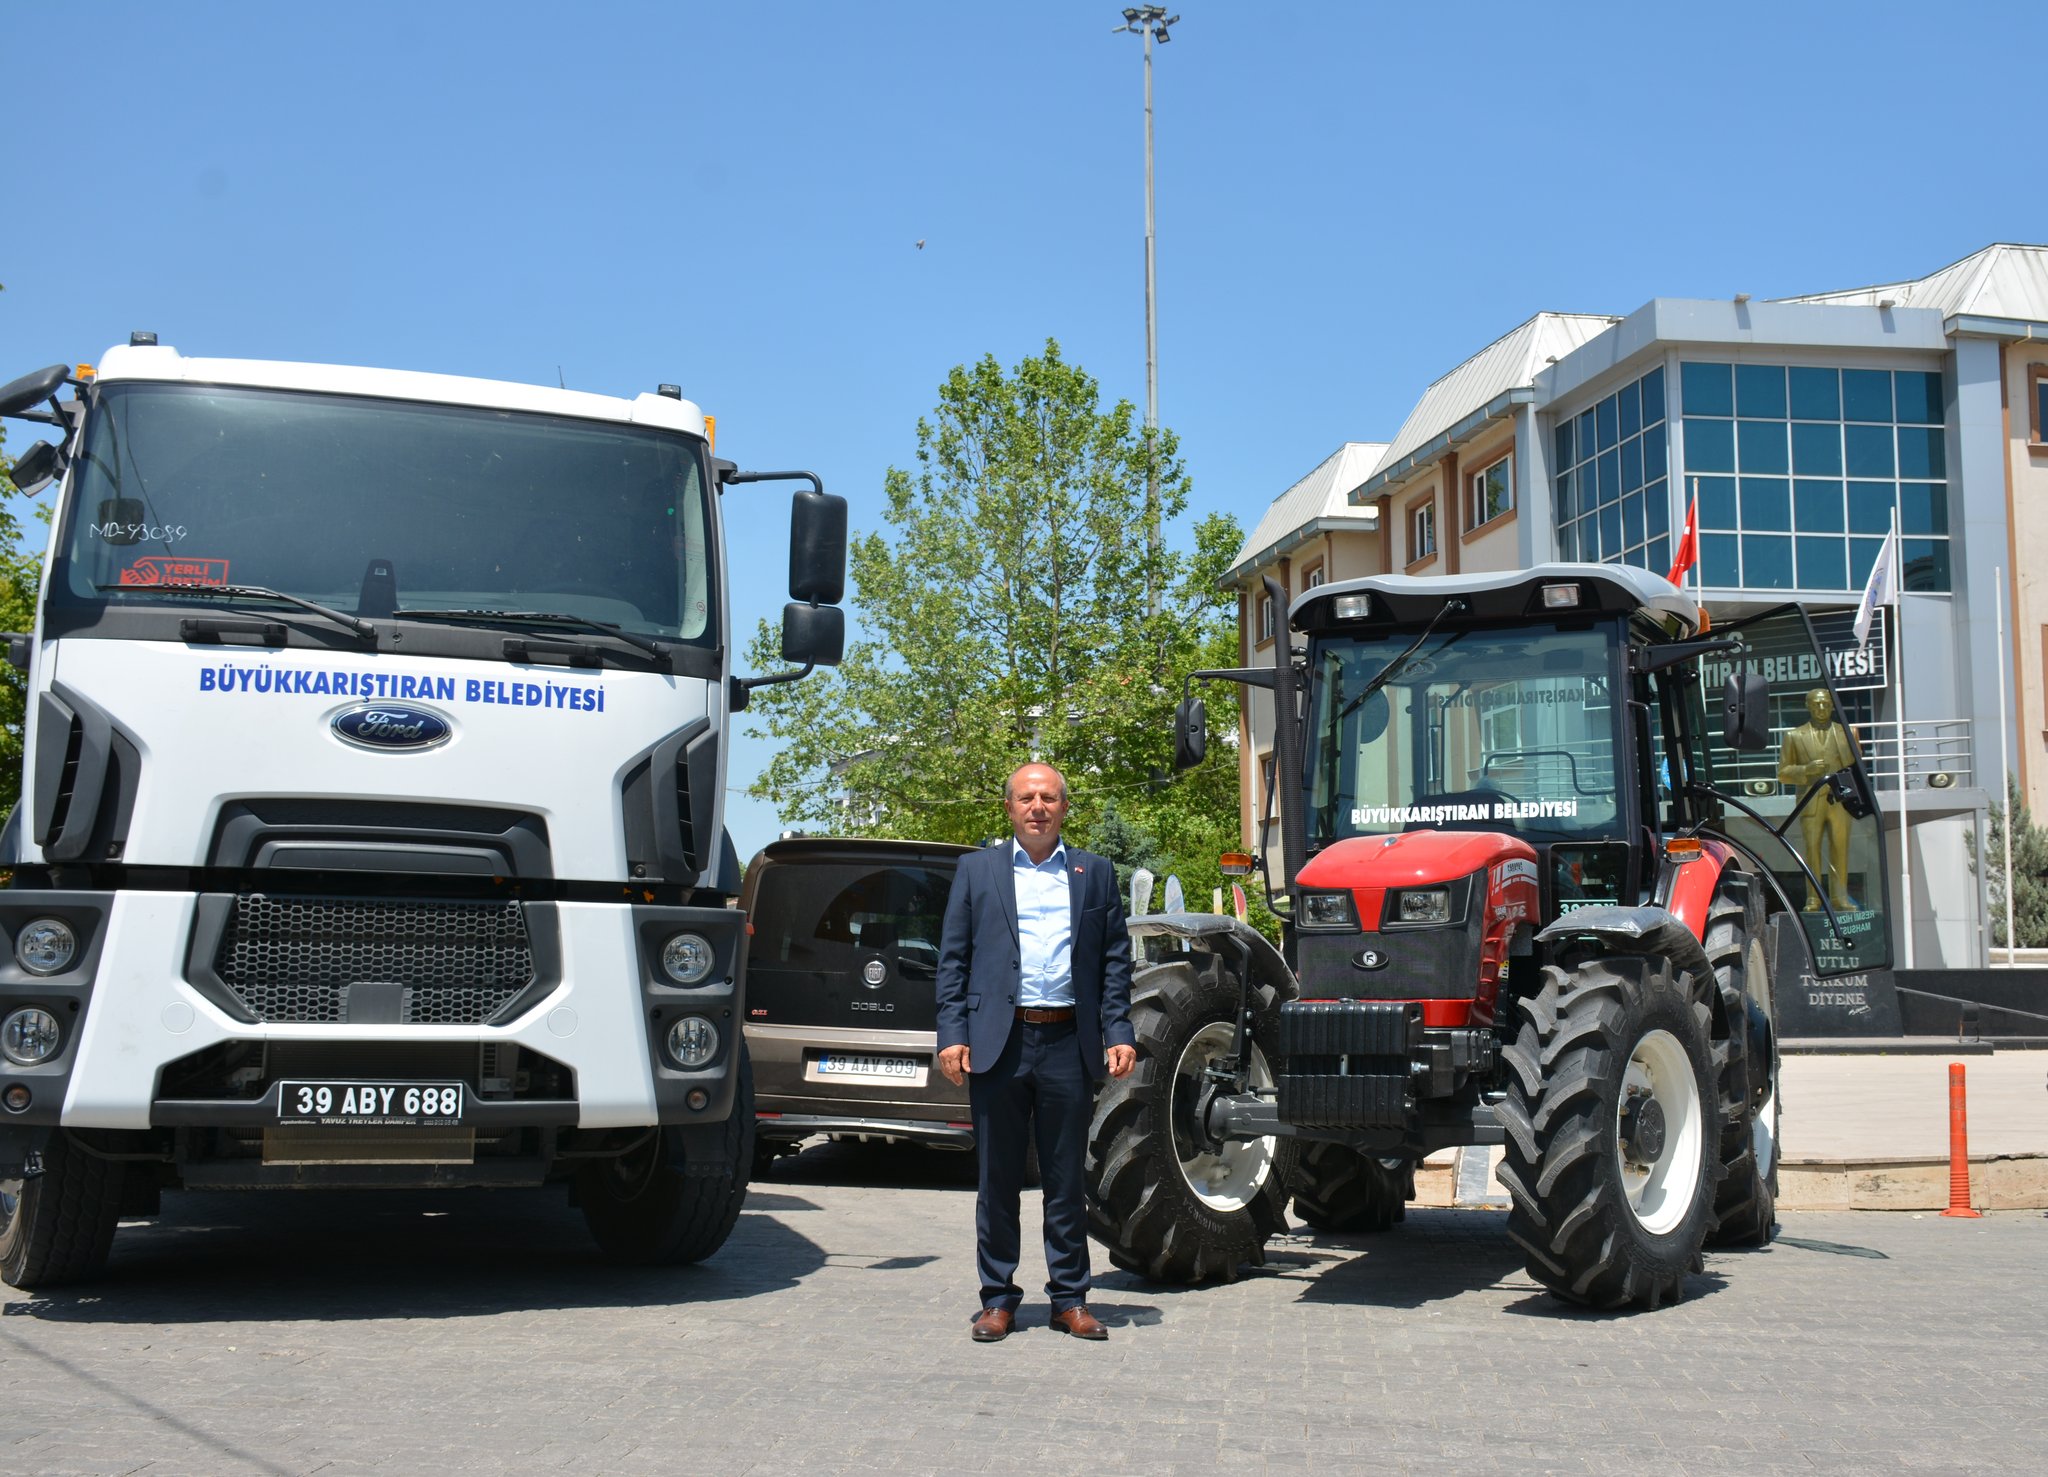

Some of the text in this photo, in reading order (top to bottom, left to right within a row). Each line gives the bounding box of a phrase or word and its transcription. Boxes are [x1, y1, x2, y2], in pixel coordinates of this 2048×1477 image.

[164, 563, 209, 575] YERLİ
[1763, 643, 1875, 683] BELEDİYESİ
[200, 663, 605, 713] BÜYÜKKARIŞTIRAN BELEDİYESİ
[357, 711, 425, 739] Ford
[1351, 796, 1578, 826] BÜYÜKKARIŞTIRAN BELEDİYESİ
[1820, 938, 1842, 951] NE
[1805, 957, 1860, 969] UTLU
[851, 1001, 895, 1012] DOBLO
[827, 1056, 847, 1071] 39
[851, 1057, 881, 1073] AAV
[884, 1059, 914, 1075] 809
[296, 1086, 458, 1116] 39 ABY 688
